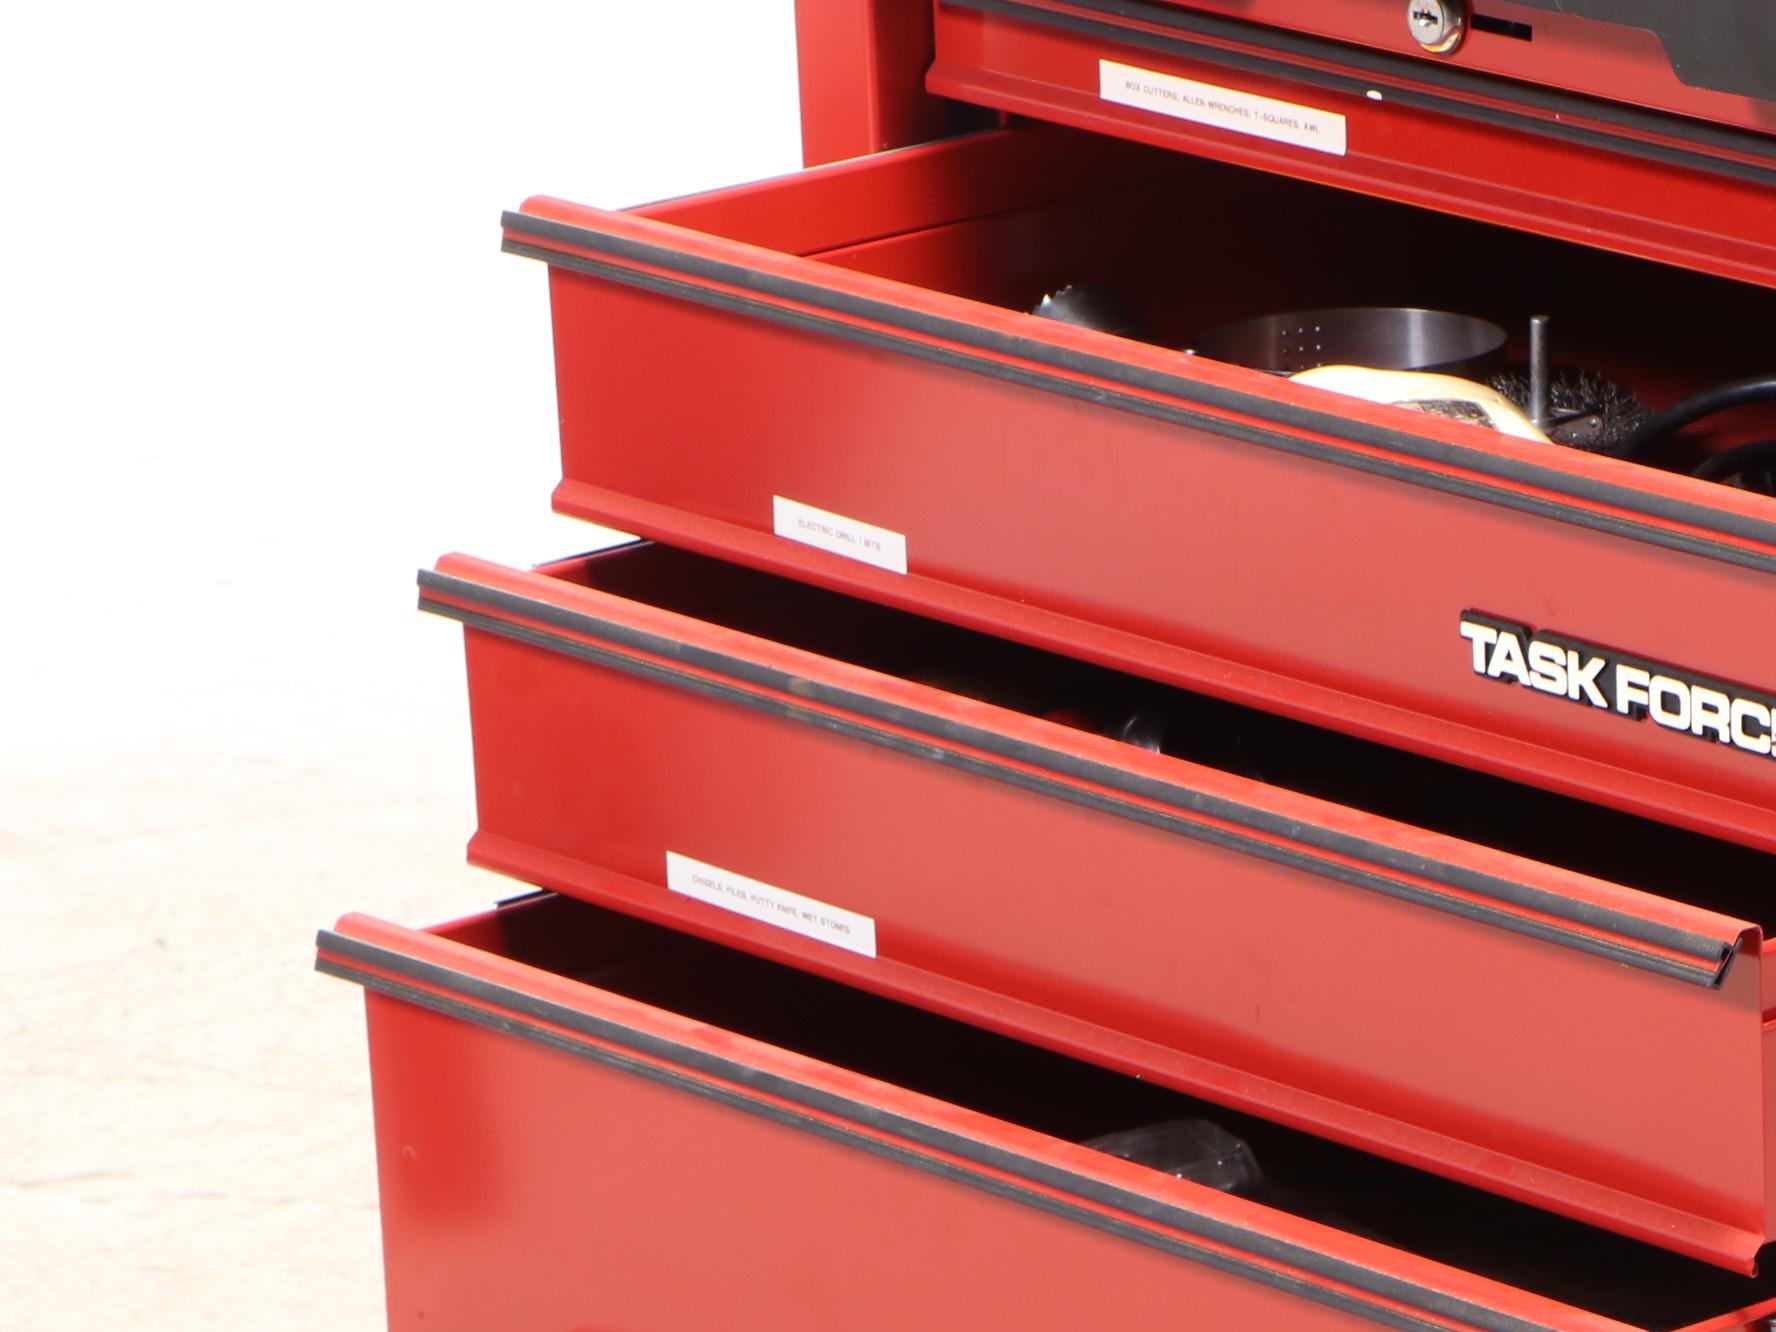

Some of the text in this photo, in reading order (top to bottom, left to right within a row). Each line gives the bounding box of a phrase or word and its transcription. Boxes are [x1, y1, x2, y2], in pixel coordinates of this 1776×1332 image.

[1125, 80, 1141, 92] BOX
[1182, 94, 1206, 107] ALLEN
[797, 518, 835, 537] ELECTRIC
[835, 528, 857, 544] DRILL
[1459, 619, 1609, 709] TASK
[802, 911, 818, 924] WET
